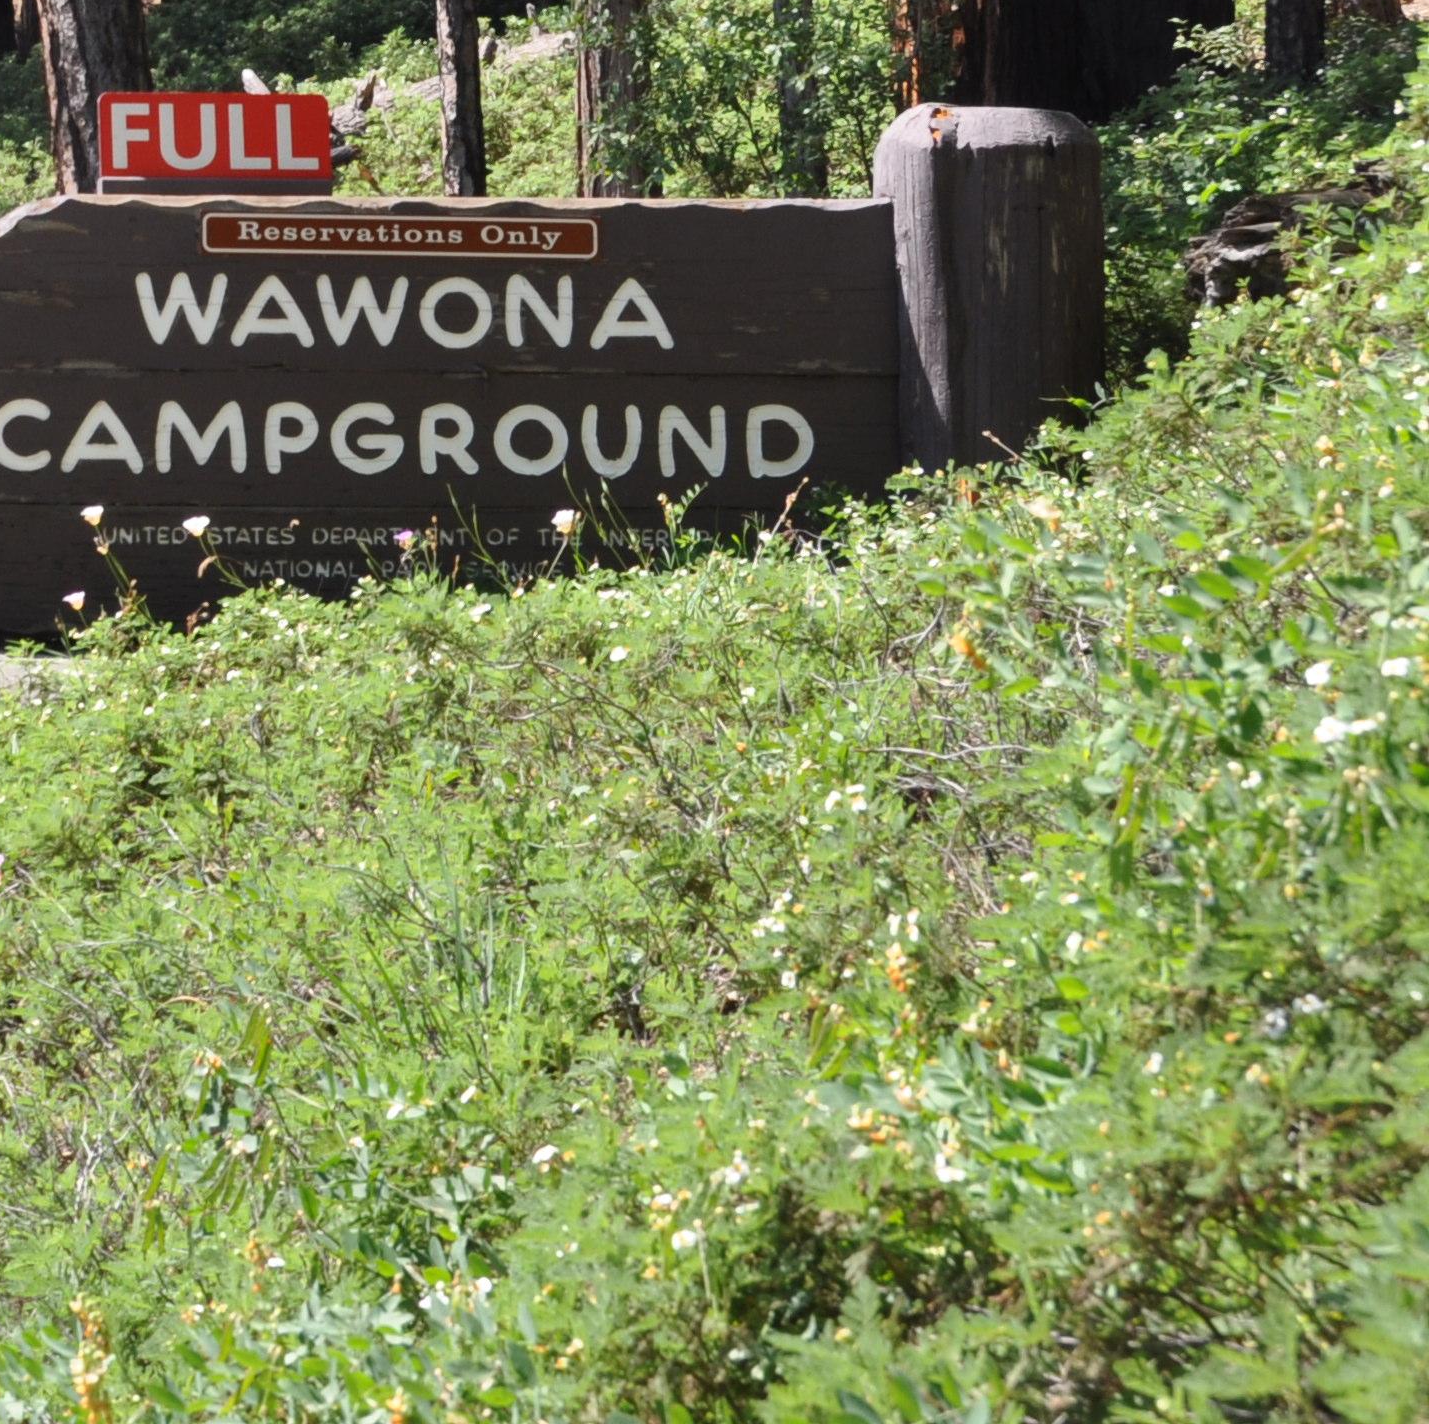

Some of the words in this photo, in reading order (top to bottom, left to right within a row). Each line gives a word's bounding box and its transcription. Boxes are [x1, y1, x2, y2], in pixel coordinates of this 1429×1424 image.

[110, 102, 319, 170] FULL
[237, 221, 463, 244] Reservations
[480, 225, 563, 250] Only
[135, 272, 674, 350] WAWONA
[106, 526, 188, 545] UNITED
[206, 526, 295, 545] STATES
[486, 528, 520, 546] OF
[243, 560, 360, 577] NATIONAL
